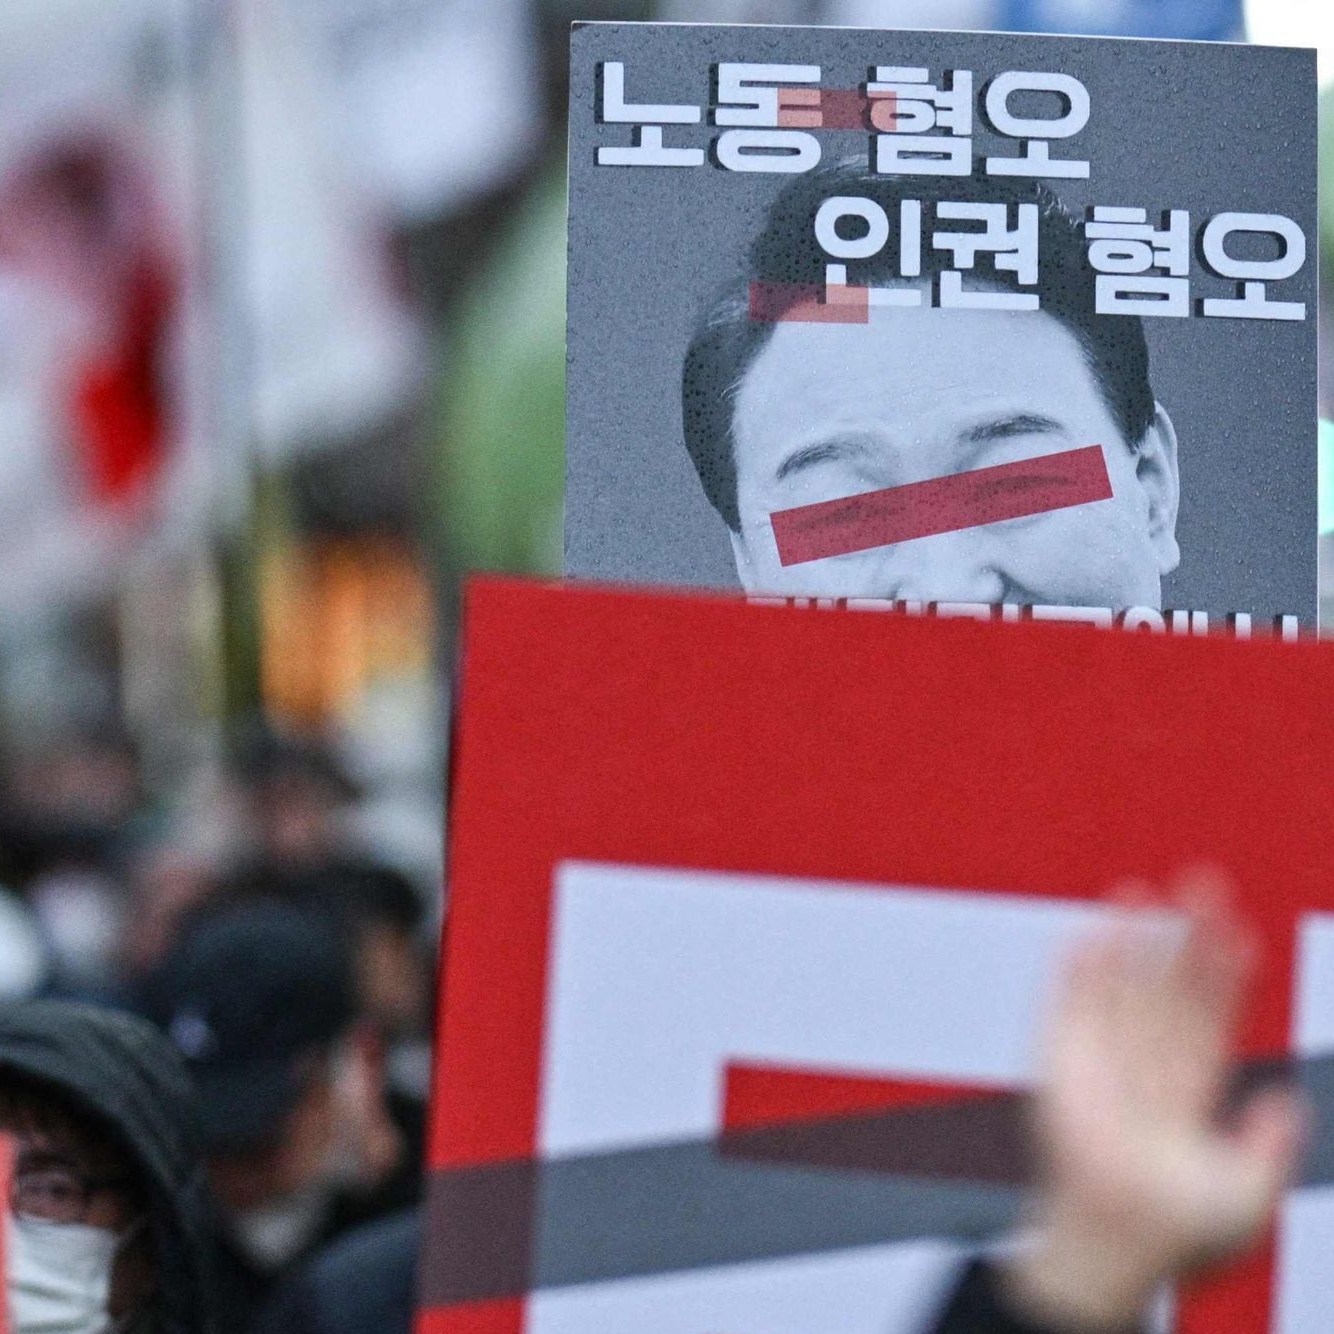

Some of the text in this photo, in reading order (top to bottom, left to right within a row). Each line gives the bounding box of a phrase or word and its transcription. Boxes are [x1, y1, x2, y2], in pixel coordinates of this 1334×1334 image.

[596, 60, 1091, 178] 노동 혐오
[814, 195, 1307, 321] 인권 혐오
